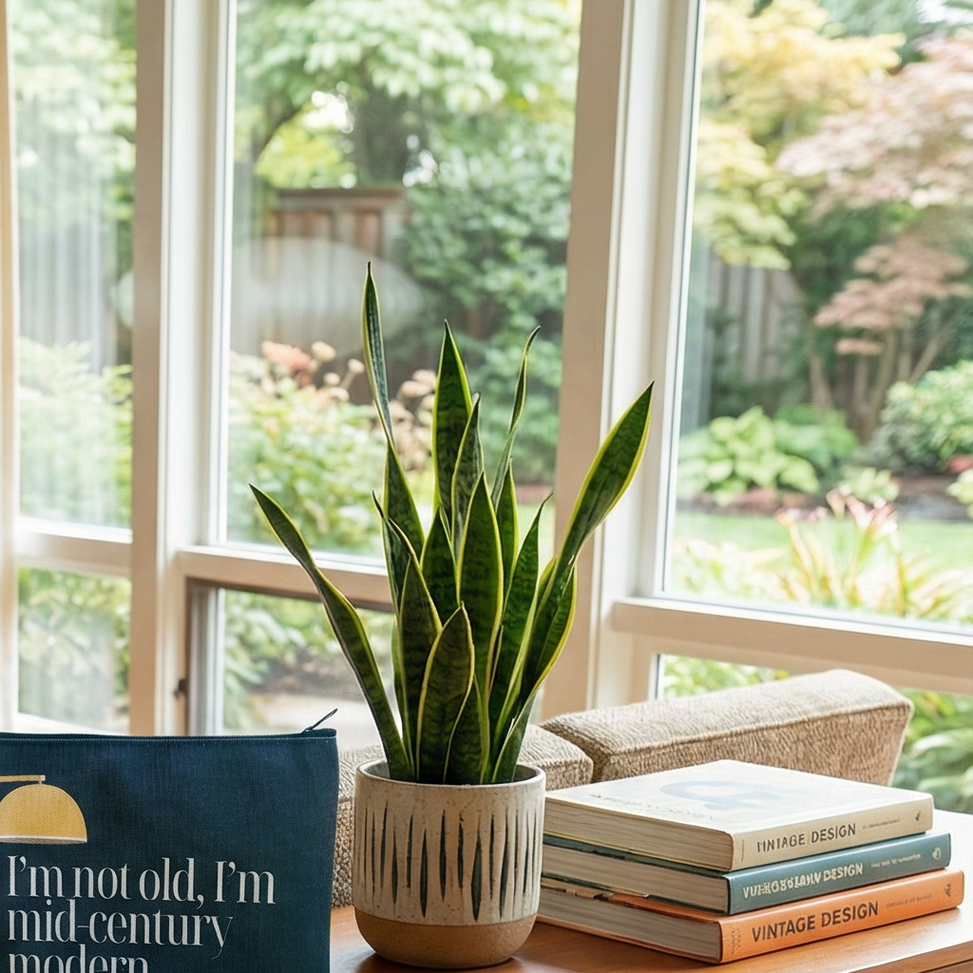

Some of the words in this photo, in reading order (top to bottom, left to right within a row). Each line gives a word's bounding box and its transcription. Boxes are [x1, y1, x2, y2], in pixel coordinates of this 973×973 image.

[811, 823, 857, 845] DESIGN
[7, 855, 65, 898] I’m
[73, 863, 132, 900] not
[138, 857, 205, 910] old,
[214, 860, 276, 905] I’m
[823, 861, 865, 884] DESIGN
[7, 898, 233, 960] mid-century
[752, 914, 816, 943] VINTAGE
[821, 900, 879, 928] DESIGN
